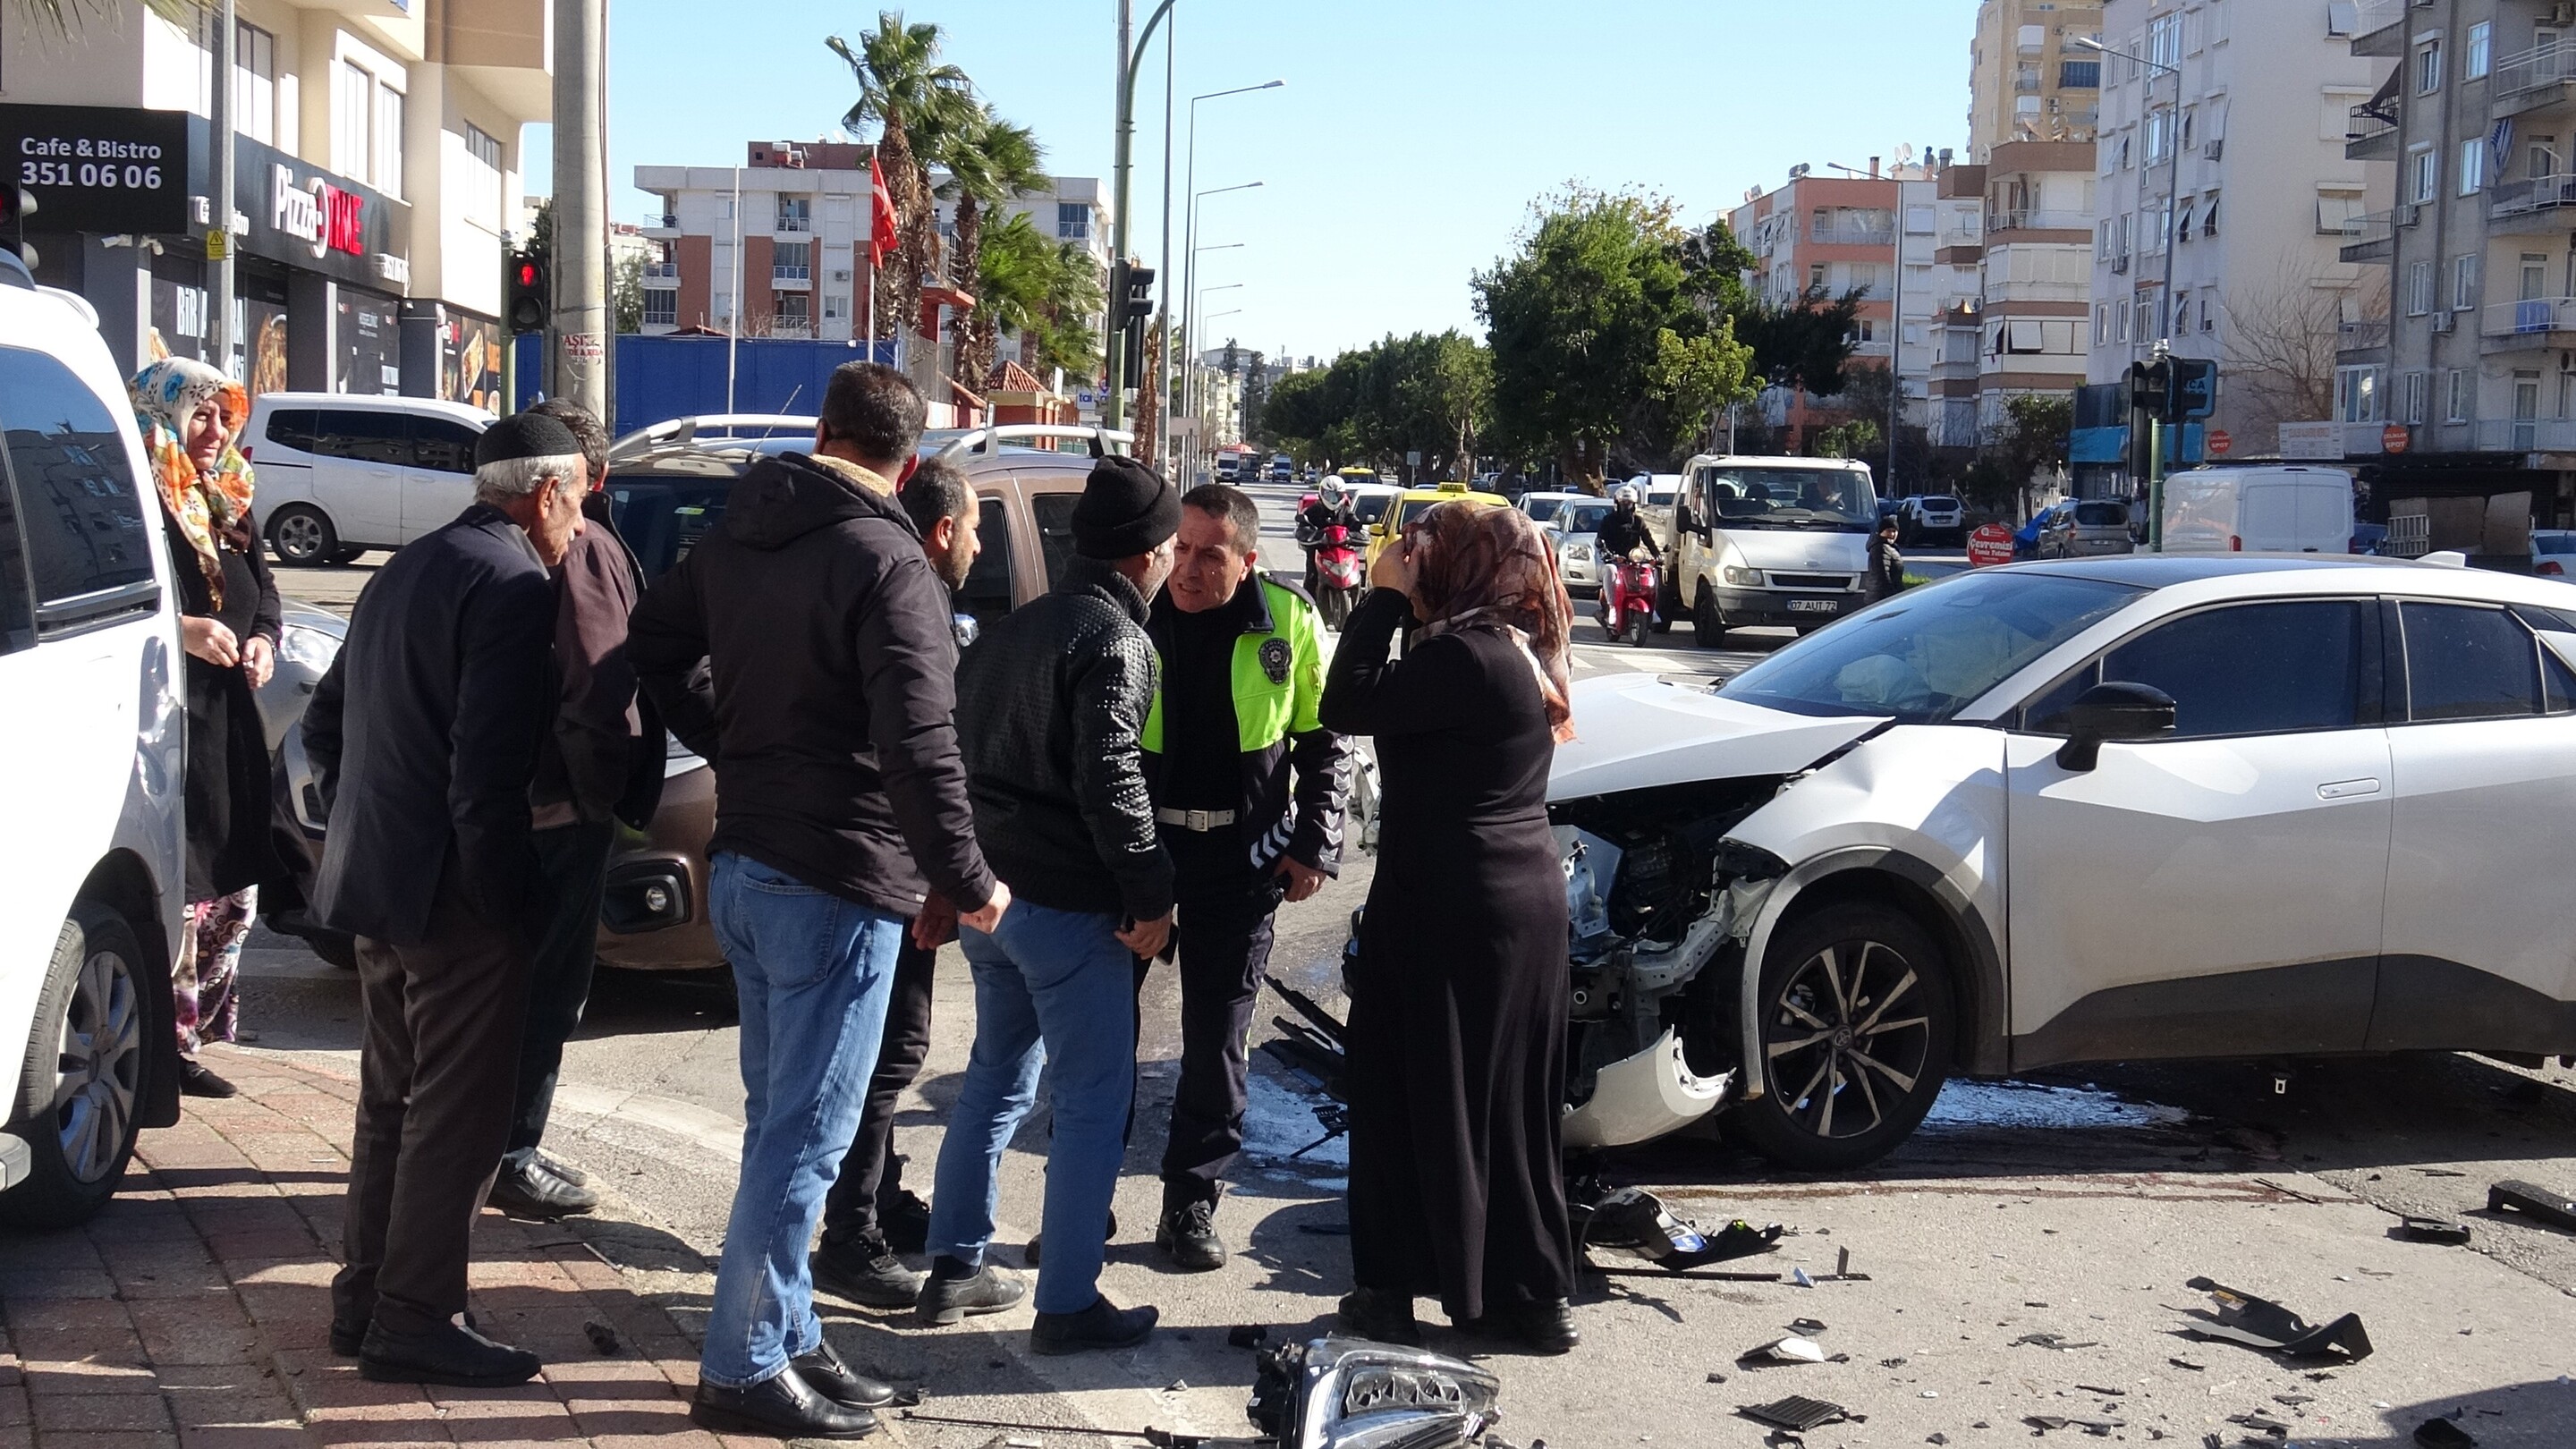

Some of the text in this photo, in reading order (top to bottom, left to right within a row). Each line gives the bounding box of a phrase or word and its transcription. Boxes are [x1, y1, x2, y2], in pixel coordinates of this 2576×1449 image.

[21, 138, 162, 160] Cafe & Bistro
[21, 162, 162, 190] 351 06 06
[271, 163, 318, 242] Pizza
[1791, 601, 1802, 610] 07
